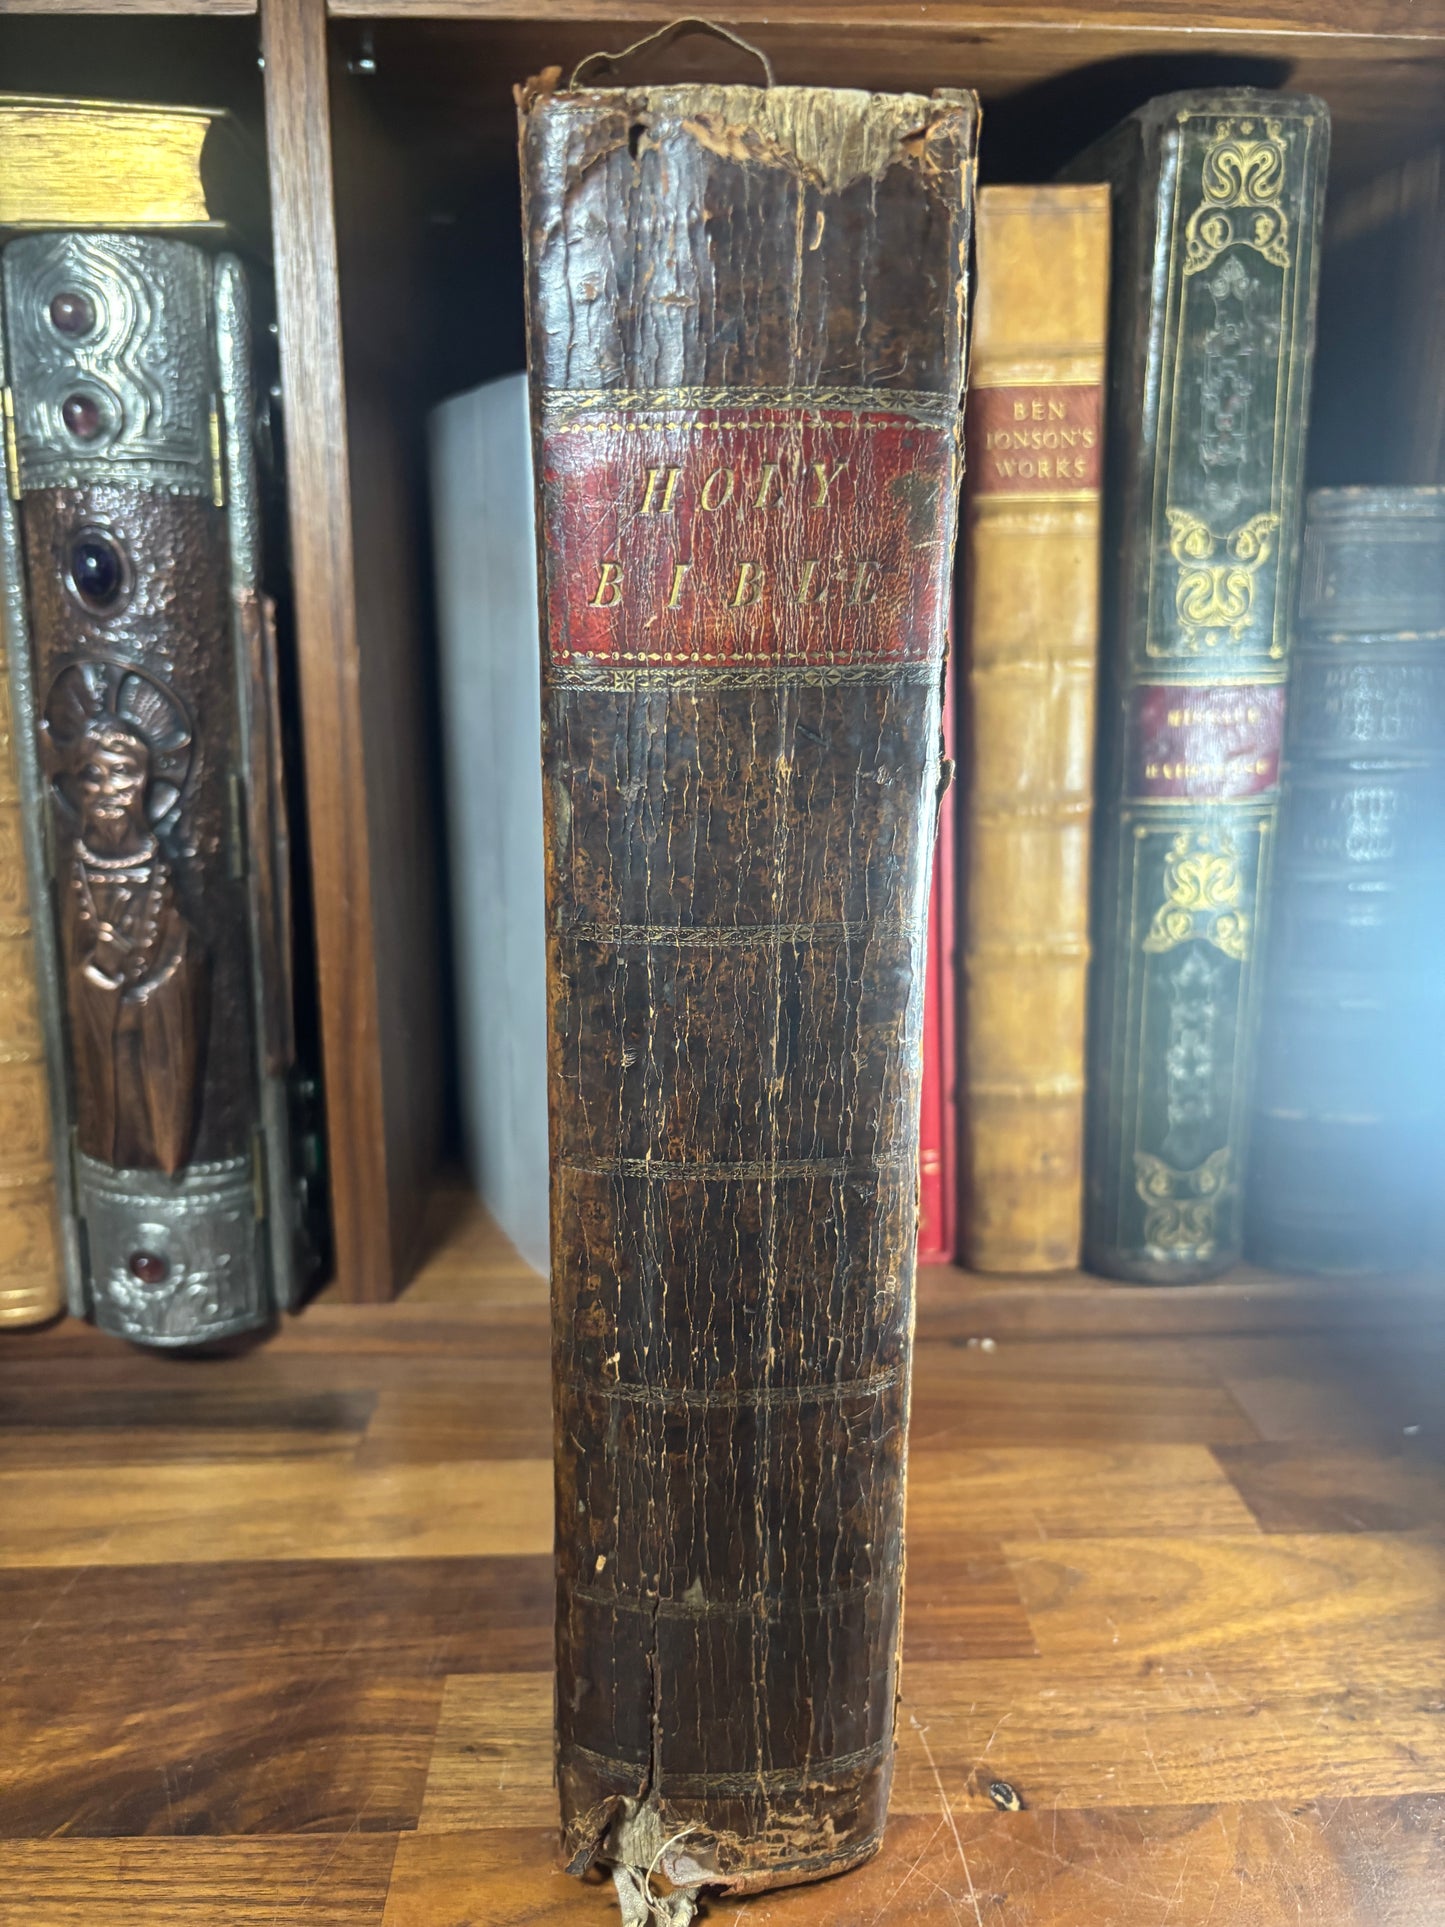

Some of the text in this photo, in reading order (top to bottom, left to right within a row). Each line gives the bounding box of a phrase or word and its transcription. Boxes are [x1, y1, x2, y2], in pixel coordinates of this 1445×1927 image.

[1013, 399, 1066, 421] BEN
[995, 456, 1086, 479] WORKS
[639, 462, 848, 514] HOLY
[588, 560, 881, 608] BIBLE
